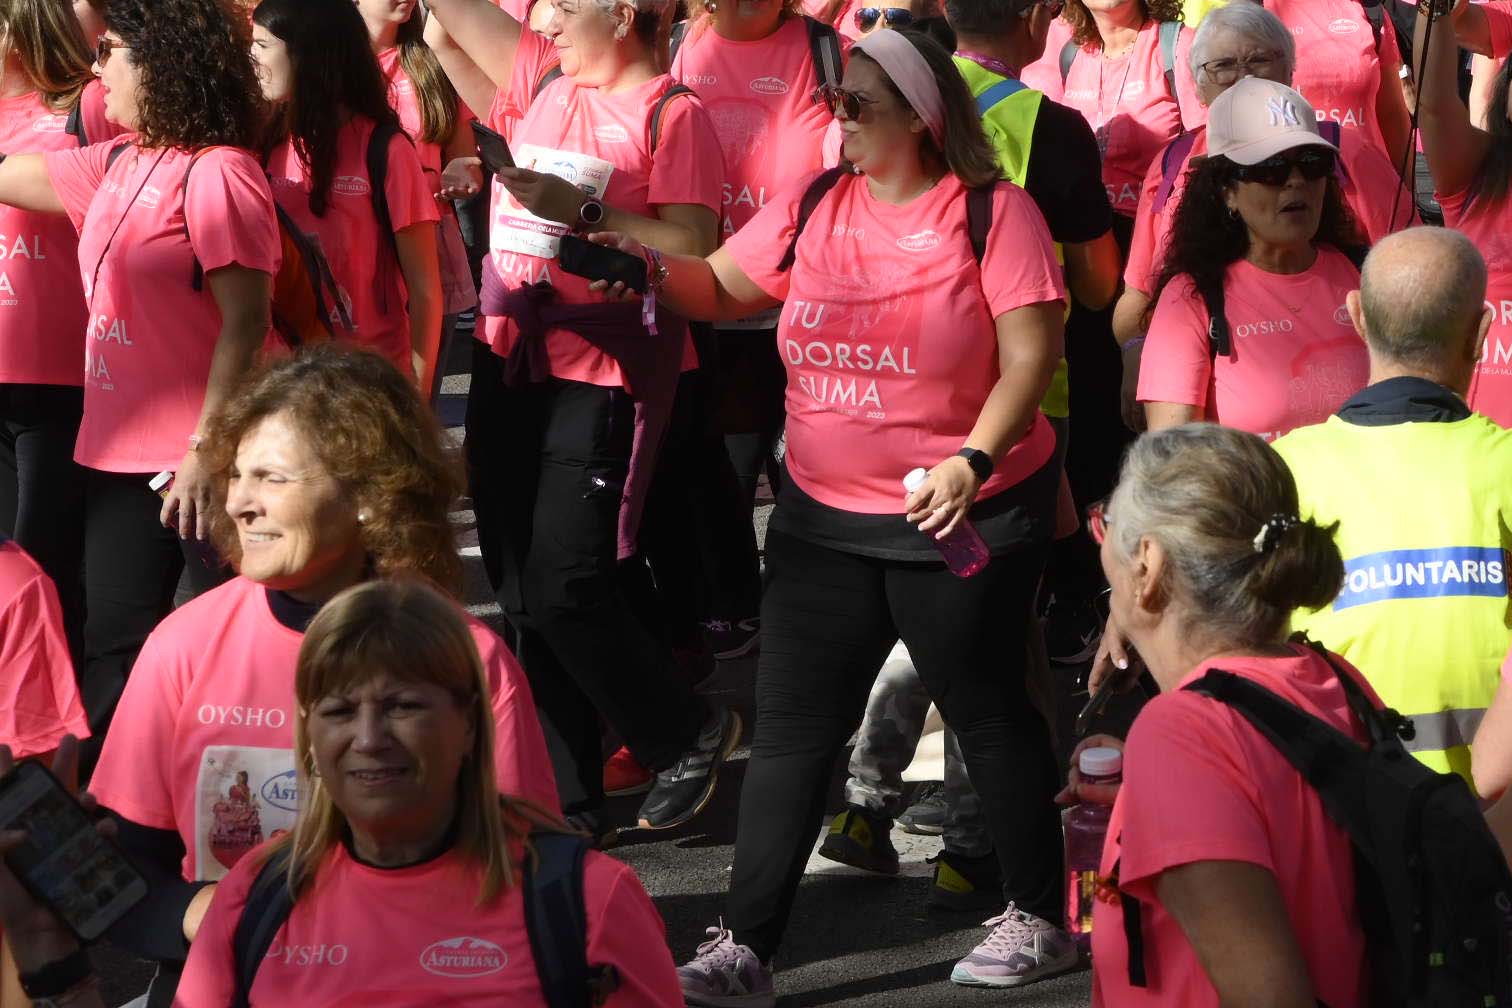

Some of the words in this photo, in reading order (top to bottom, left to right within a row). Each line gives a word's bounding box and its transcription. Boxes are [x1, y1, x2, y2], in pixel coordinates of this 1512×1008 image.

[789, 300, 825, 329] TU
[1236, 319, 1294, 338] OYSHO
[786, 338, 916, 374] DORSAL
[866, 410, 886, 420] 2023
[198, 703, 286, 729] OYSHO
[269, 782, 298, 801] AST
[427, 952, 500, 968] ASTURIANA
